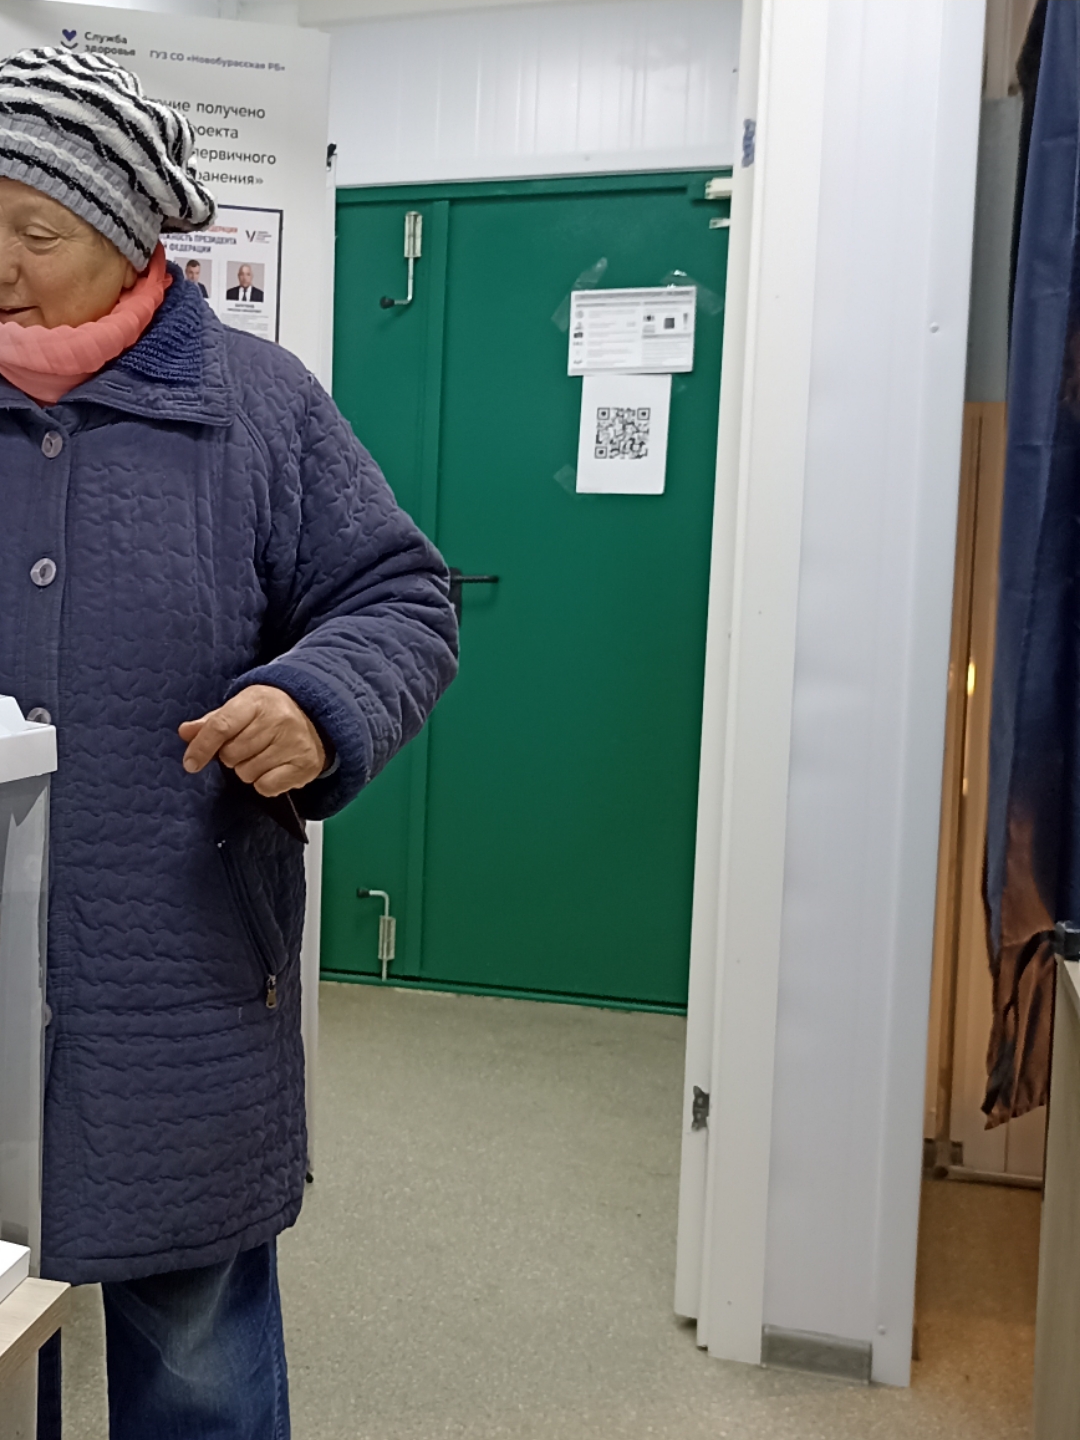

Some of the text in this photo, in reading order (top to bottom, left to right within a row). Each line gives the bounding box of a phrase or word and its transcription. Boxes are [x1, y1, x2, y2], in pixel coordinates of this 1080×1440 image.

[84, 31, 128, 45] Служба
[85, 44, 136, 58] здоровья
[170, 51, 184, 61] СО
[196, 101, 266, 119] получено
